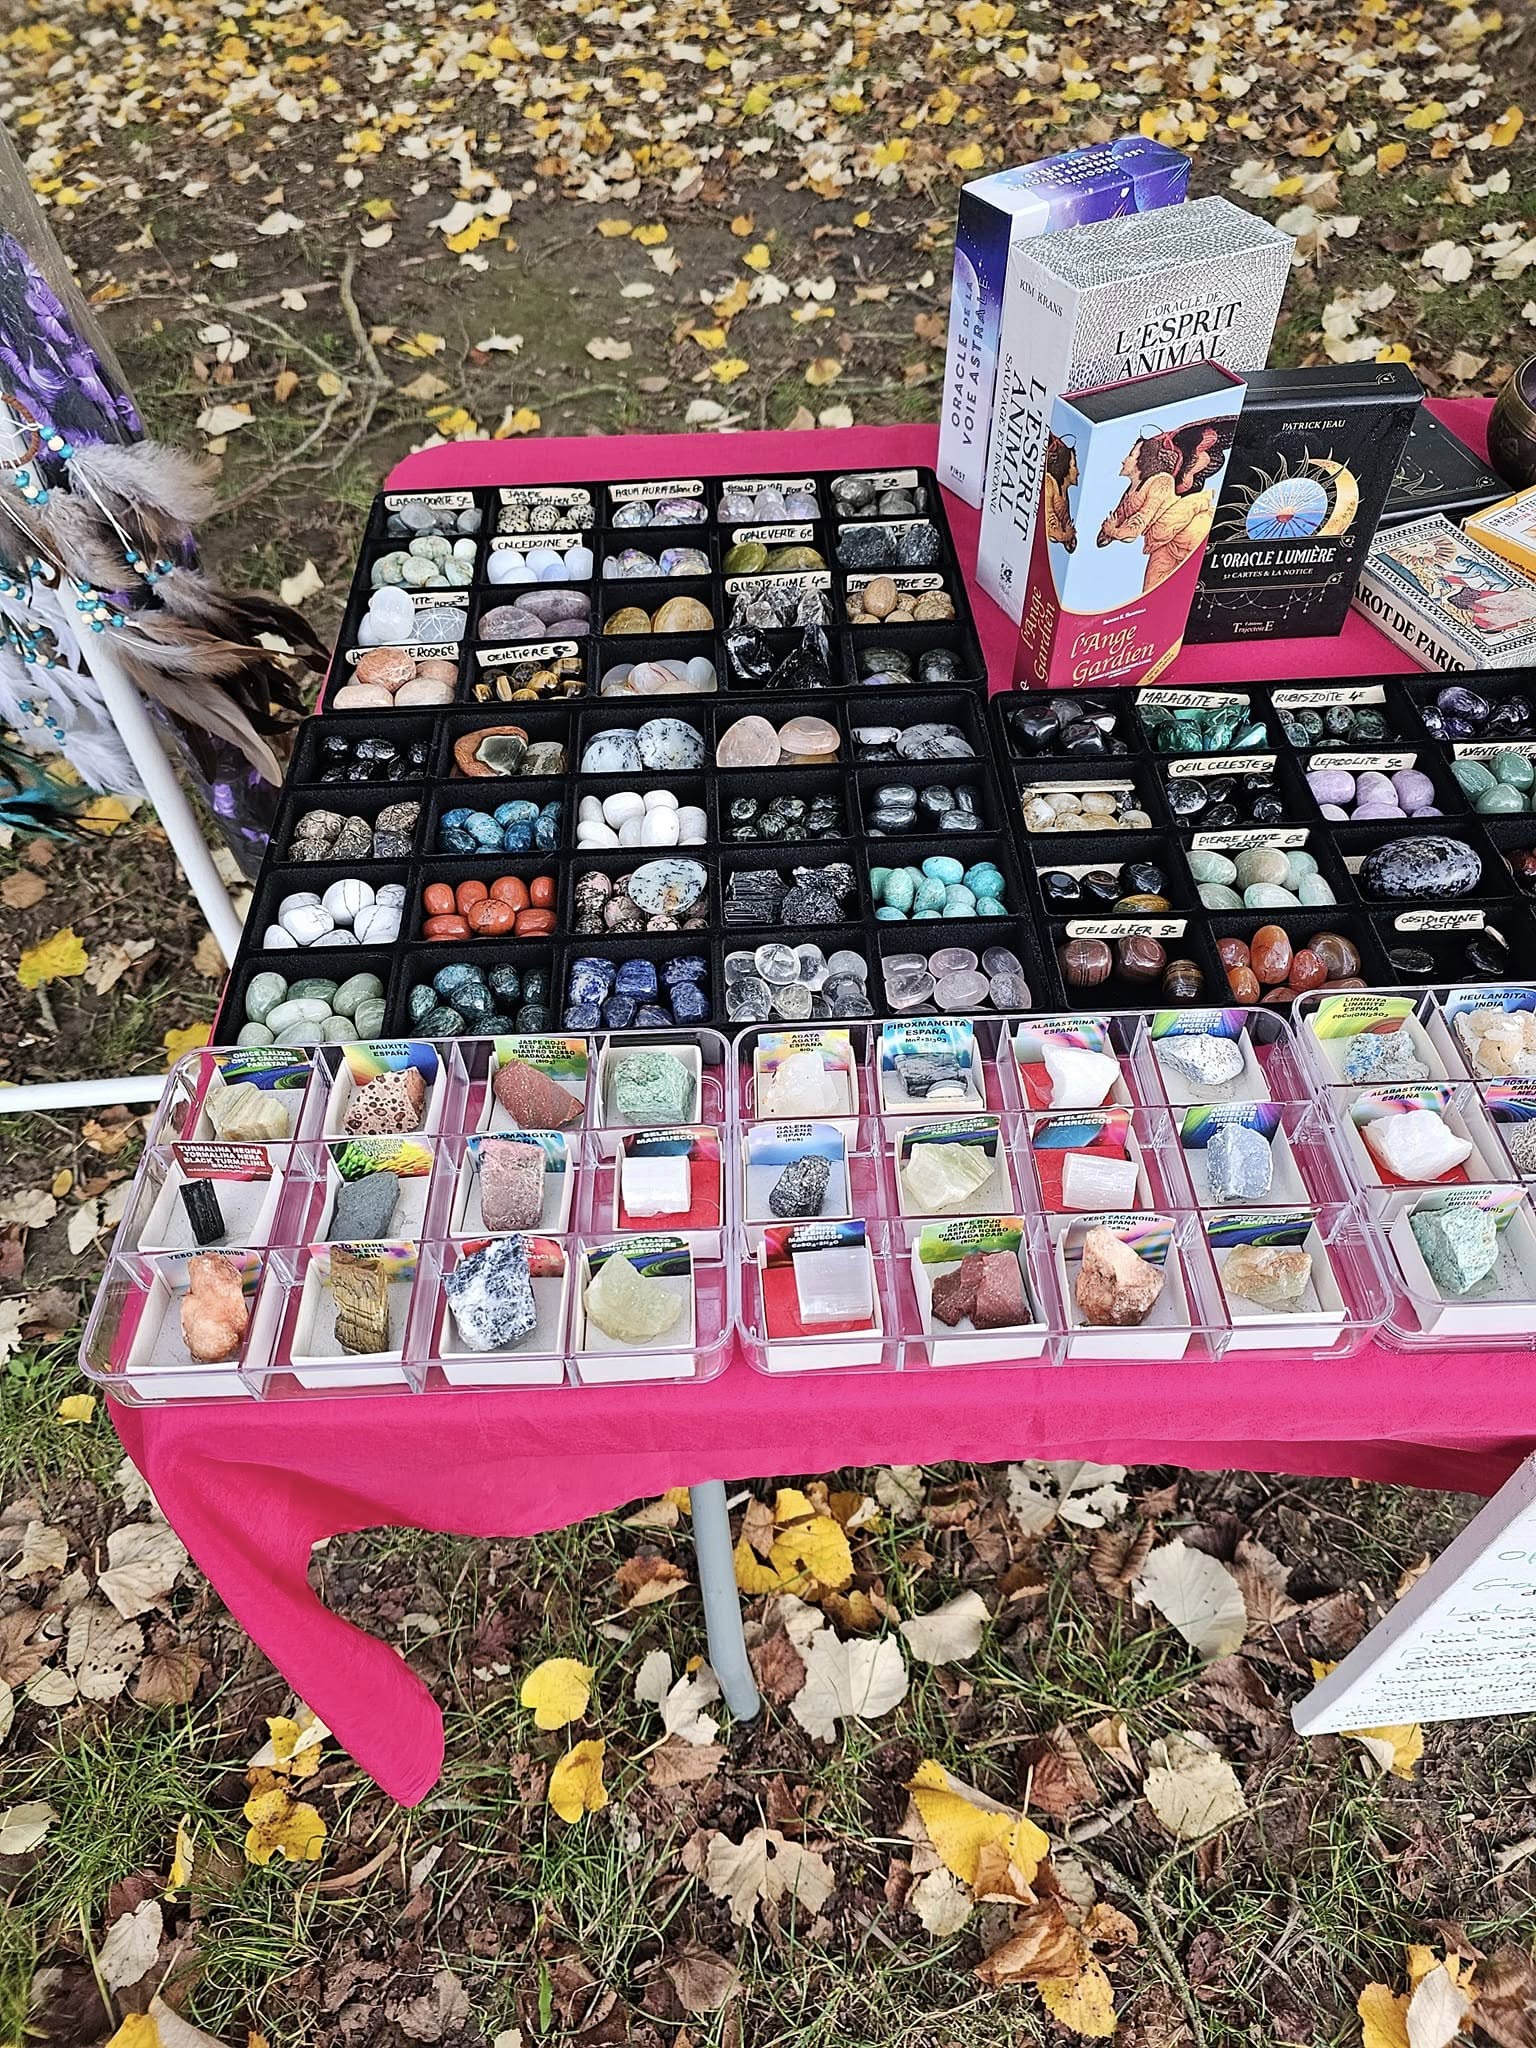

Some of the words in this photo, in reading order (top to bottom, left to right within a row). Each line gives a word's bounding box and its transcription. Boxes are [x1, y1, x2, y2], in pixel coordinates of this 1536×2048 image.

[965, 281, 974, 301] LA
[1018, 278, 1036, 299] KIM
[1037, 291, 1064, 318] KRANS
[1144, 298, 1200, 319] L'ORACLE
[1205, 292, 1221, 305] DE
[963, 307, 971, 329] DE
[1114, 301, 1242, 355] L'ESPRIT
[969, 277, 990, 386] ASTRALE
[1117, 335, 1226, 380] ANIMAL
[951, 333, 969, 428] ORACLE
[998, 353, 1014, 423] SAUVAGE
[962, 391, 977, 446] VOIE
[1281, 420, 1322, 431] PATRICK
[1322, 419, 1347, 429] JEAU
[996, 423, 1007, 447] ET
[1000, 370, 1028, 513] ANIMAL
[1013, 375, 1048, 542] L'ESPRIT
[950, 465, 966, 481] FIRST
[990, 450, 1003, 516] INCONNU
[1488, 510, 1518, 527] GRAND
[1210, 551, 1275, 570] L'ORACLE
[1275, 545, 1337, 566] LUMIÈRE
[1231, 570, 1262, 579] CARTES
[1263, 569, 1270, 577] &
[1271, 569, 1282, 577] LA
[1282, 567, 1314, 577] NOTICE
[1021, 586, 1042, 650] l'Ange
[1034, 602, 1056, 683] Gardien
[1070, 625, 1137, 659] l'Ange
[1391, 613, 1417, 642] DE
[1414, 630, 1466, 672] PARIS
[1072, 642, 1155, 688] Gardien
[1207, 759, 1260, 770] CELESTE
[1075, 925, 1108, 935] OEIL
[1459, 992, 1528, 1001] HEULANDITA
[887, 1019, 967, 1031] PIROXMANGITA
[1031, 1019, 1095, 1030] ALABASTRINA
[1371, 1085, 1439, 1097] ALABASTRINA
[1048, 1118, 1112, 1128] MARRUECOS
[178, 1145, 232, 1153] TURMALINA
[232, 1147, 264, 1156] NEGRA
[637, 1134, 701, 1145] MARRUECOS
[183, 1151, 236, 1159] TORMALINA
[216, 1158, 266, 1167] TURMALINE
